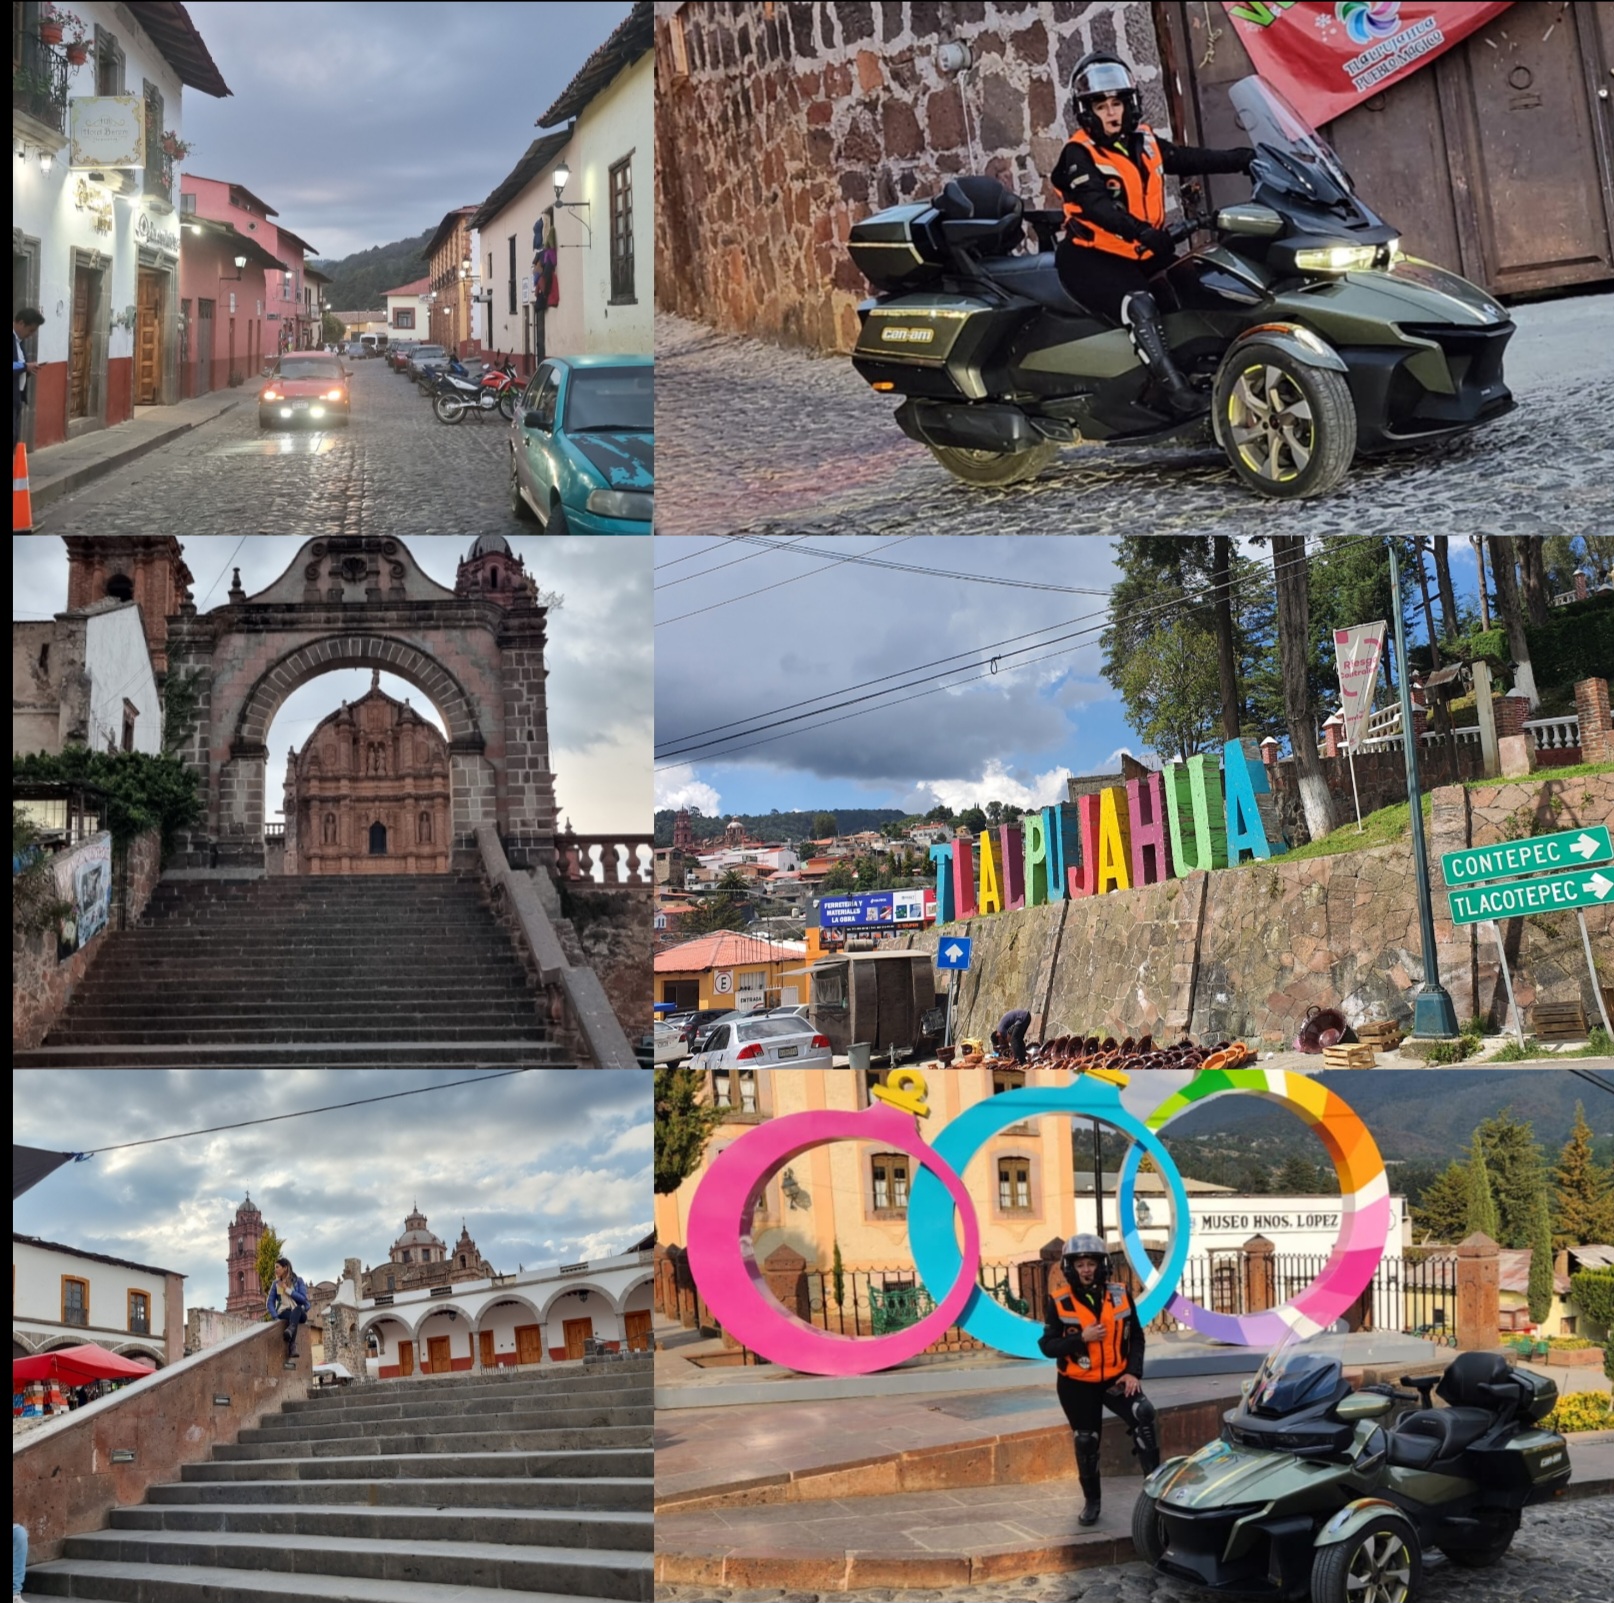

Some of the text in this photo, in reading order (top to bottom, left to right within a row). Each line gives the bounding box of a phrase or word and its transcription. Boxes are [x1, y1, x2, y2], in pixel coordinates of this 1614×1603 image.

[930, 737, 1286, 926] TLALPUJAHUA
[1451, 842, 1561, 878] CONTEPEC
[858, 899, 863, 907] Y
[1454, 880, 1578, 917] TLACOTEPEC
[826, 908, 861, 917] MATERIALES
[721, 977, 727, 990] E
[1201, 1214, 1249, 1230] MUSEO
[1253, 1214, 1293, 1229] HNOS.
